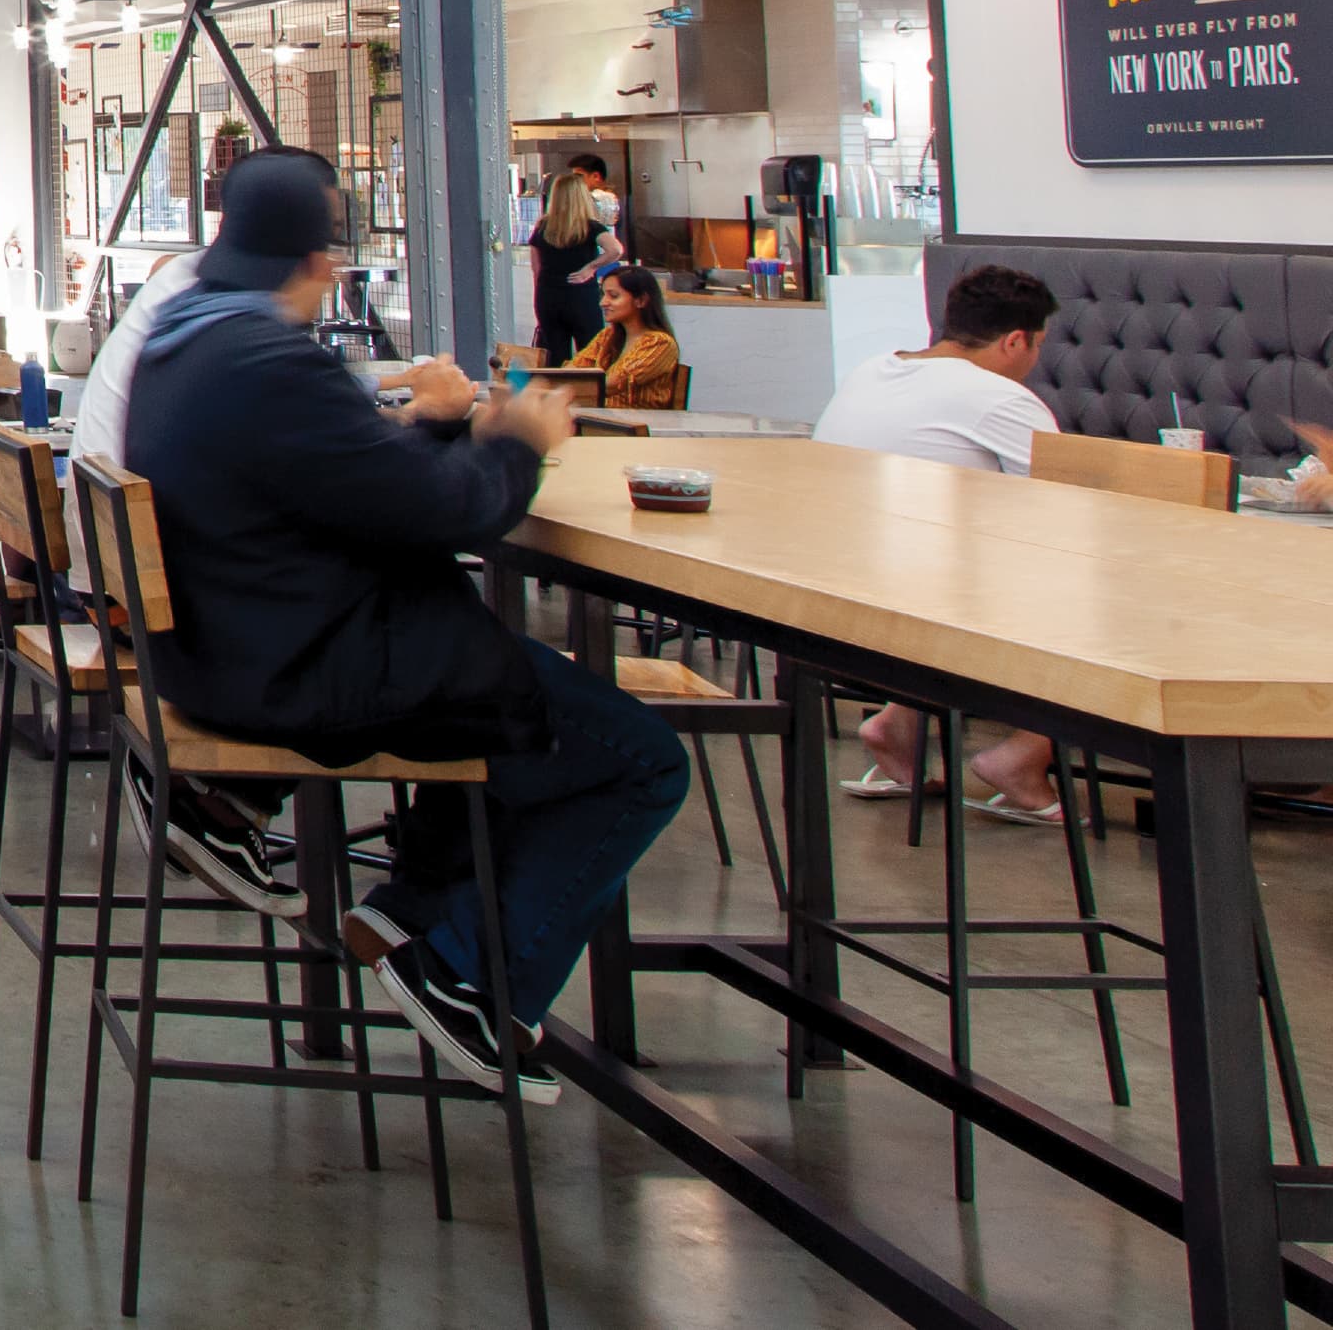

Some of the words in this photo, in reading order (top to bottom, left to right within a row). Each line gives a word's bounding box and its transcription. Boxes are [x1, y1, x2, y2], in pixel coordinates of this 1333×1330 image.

[1108, 27, 1148, 43] WILL
[1155, 22, 1199, 39] EVER
[1205, 18, 1238, 35] FLY
[1246, 13, 1298, 31] FROM
[1108, 53, 1148, 95] NEW
[1153, 49, 1208, 92] YORK
[1209, 59, 1223, 80] TO
[1227, 42, 1300, 88] PARIS.
[1146, 120, 1203, 134] ORVILLE
[1208, 118, 1265, 133] WRIGHT
